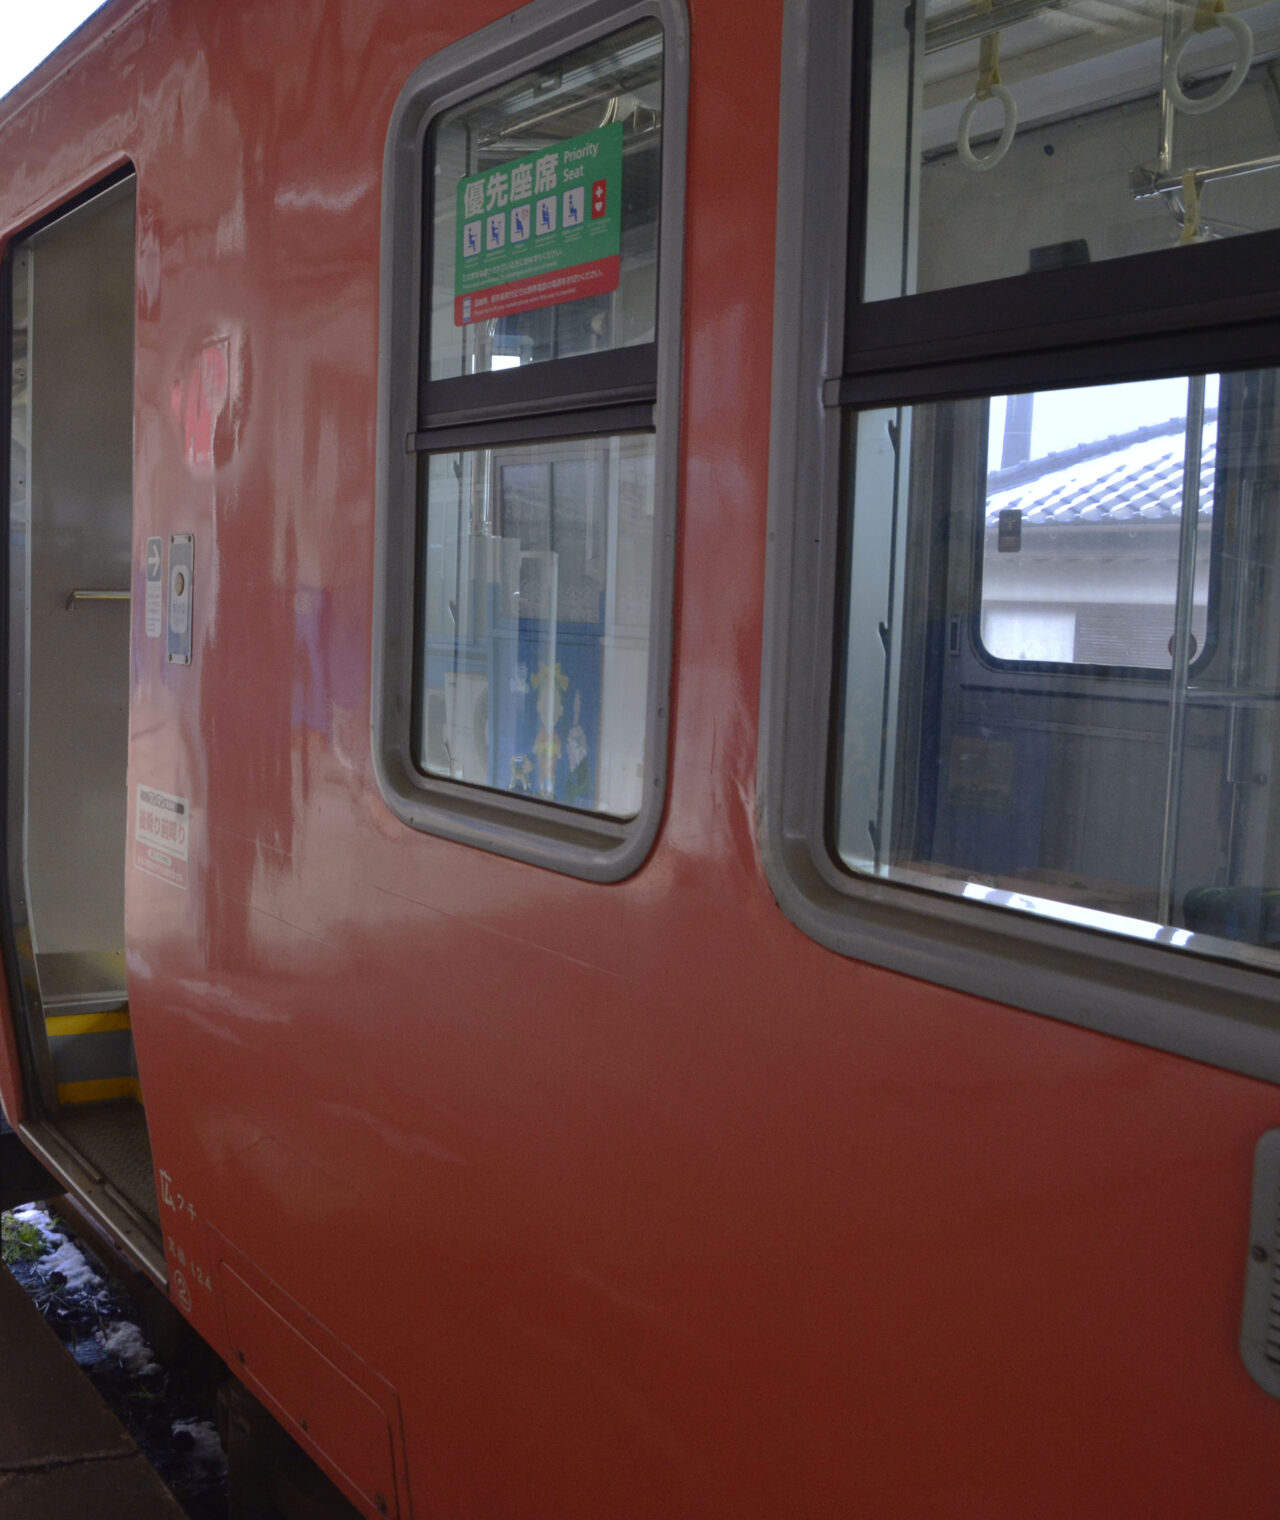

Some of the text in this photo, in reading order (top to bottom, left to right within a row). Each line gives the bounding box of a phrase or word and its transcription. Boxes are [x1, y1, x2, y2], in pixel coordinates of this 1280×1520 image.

[563, 143, 599, 164] Priority
[563, 164, 585, 183] Seat
[464, 152, 559, 219] 優先座席
